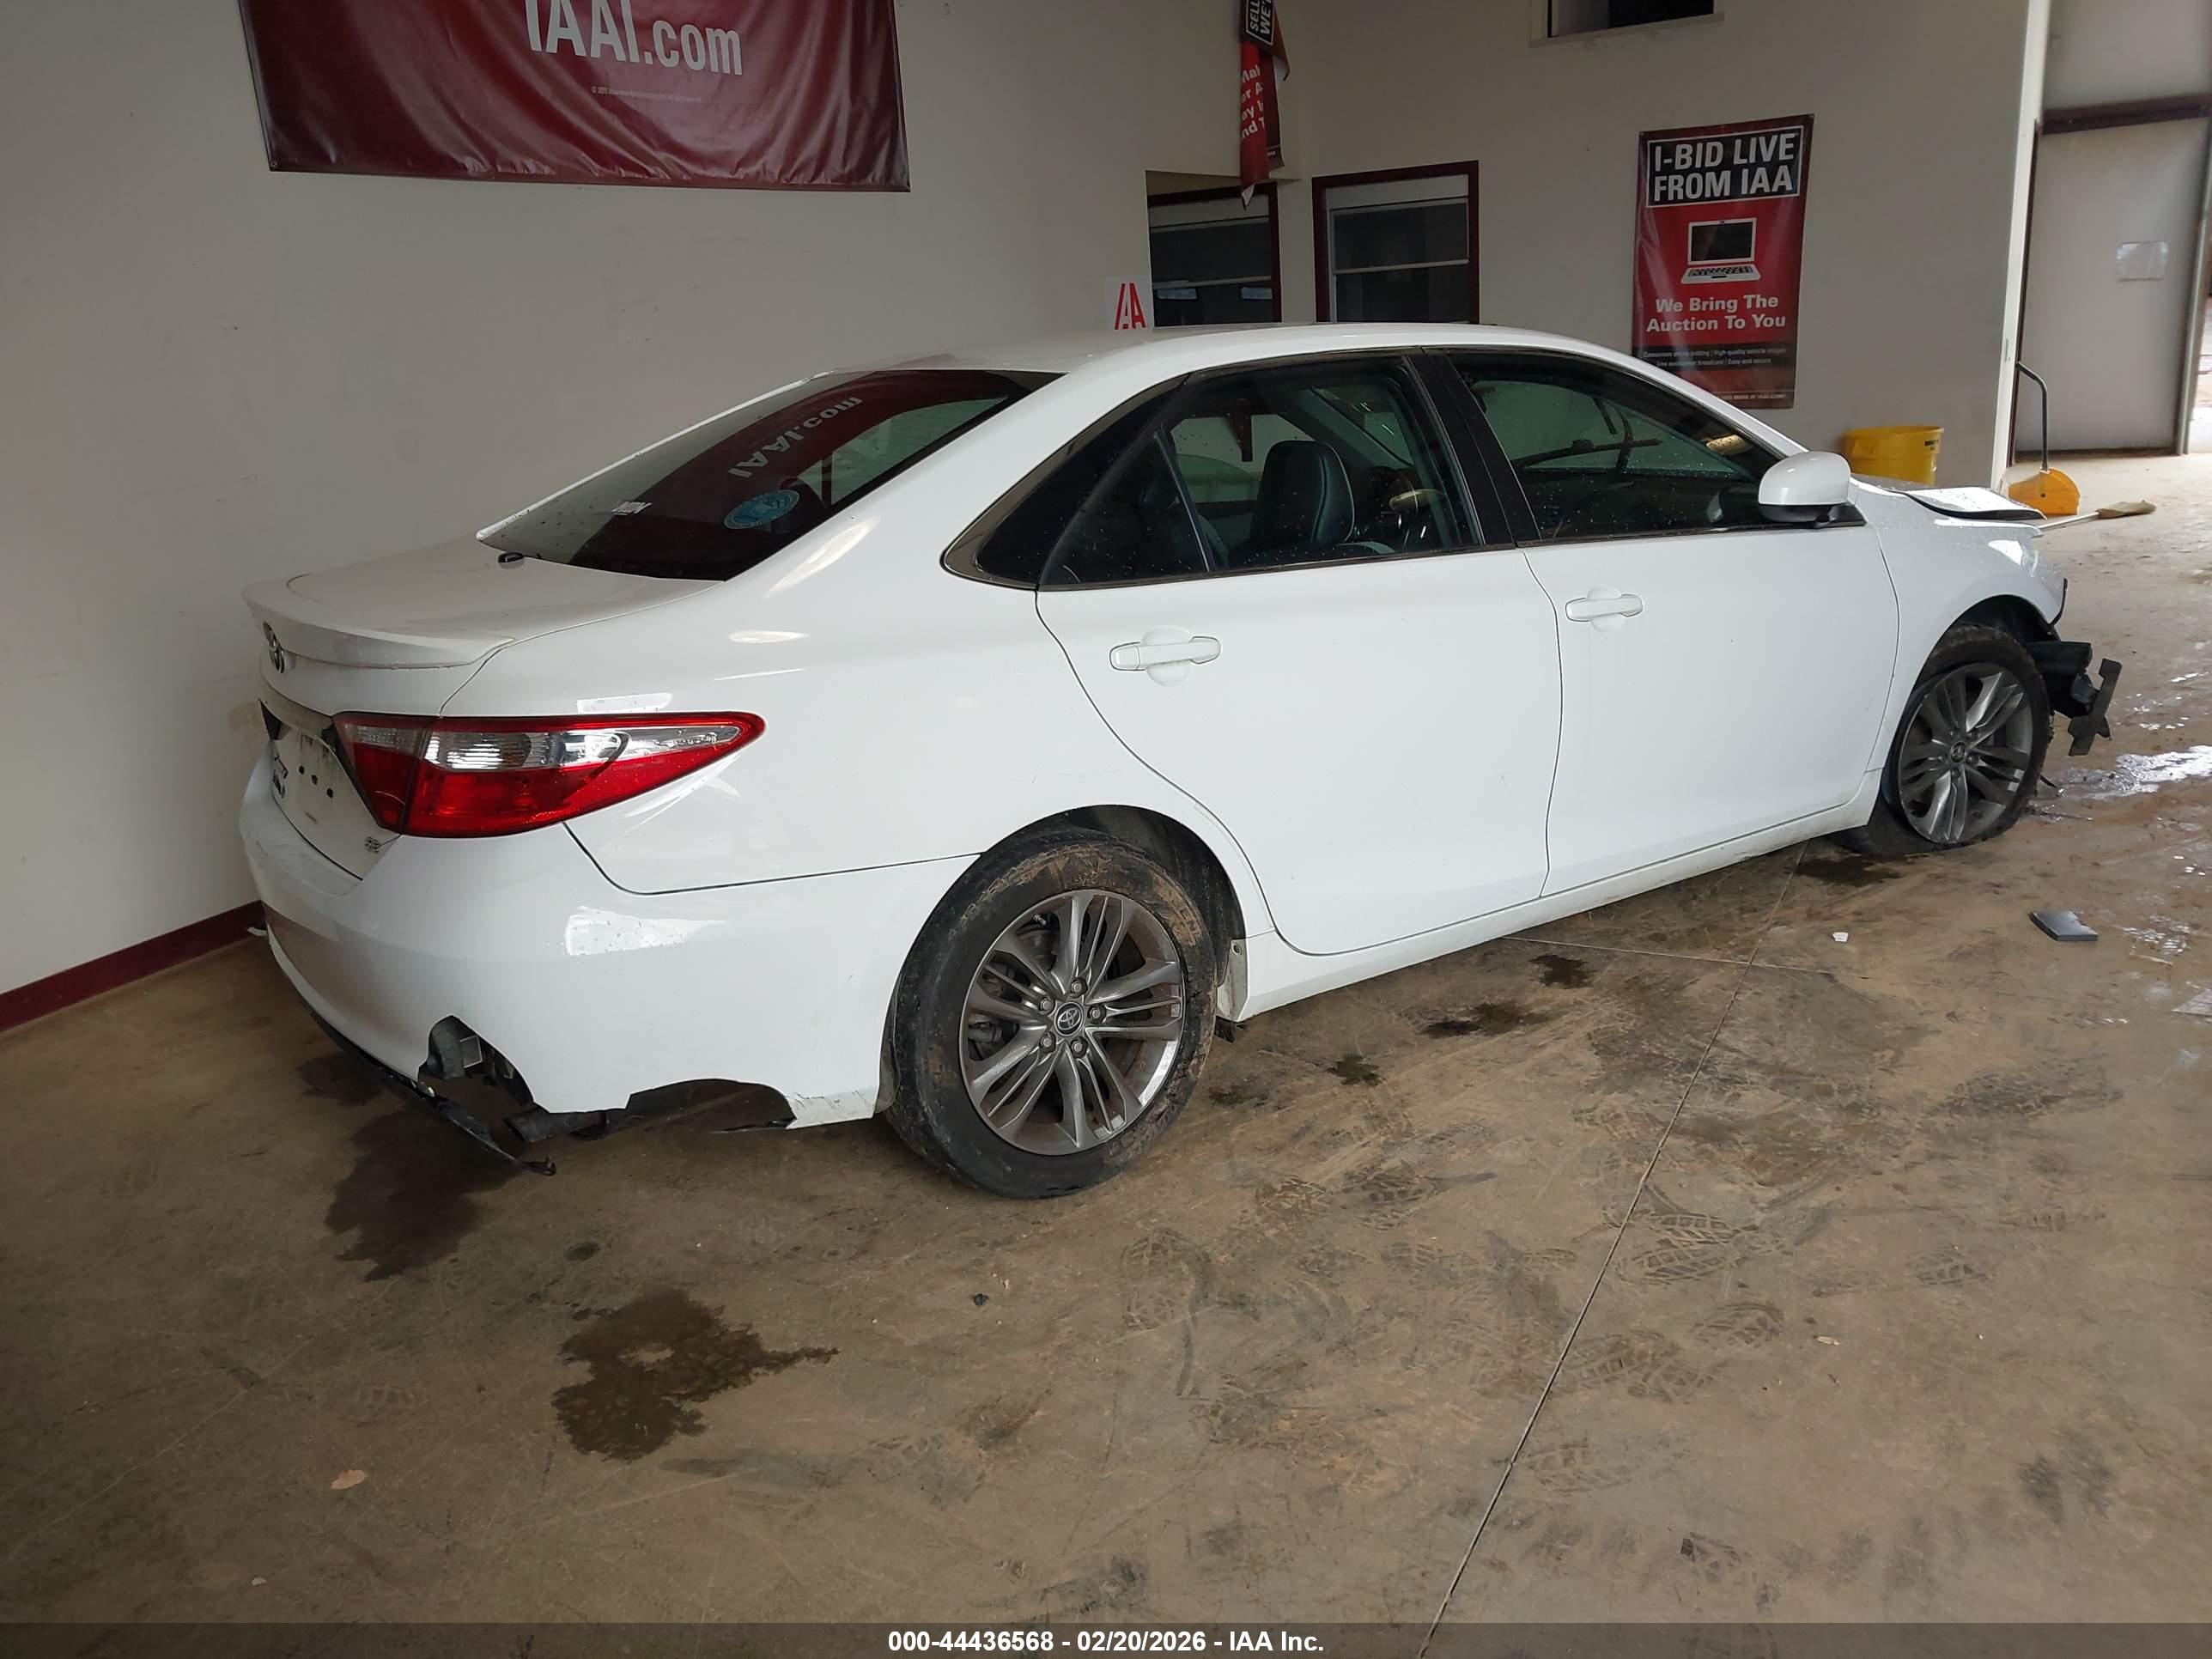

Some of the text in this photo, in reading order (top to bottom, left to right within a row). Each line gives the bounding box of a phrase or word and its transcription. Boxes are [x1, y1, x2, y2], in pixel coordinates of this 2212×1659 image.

[526, 0, 743, 76] IAAI.com
[1655, 132, 1796, 172] I-BID LIVE
[1654, 165, 1793, 202] FROM IAA
[1656, 295, 1779, 313] We Bring The
[1646, 313, 1786, 333] Auction To You
